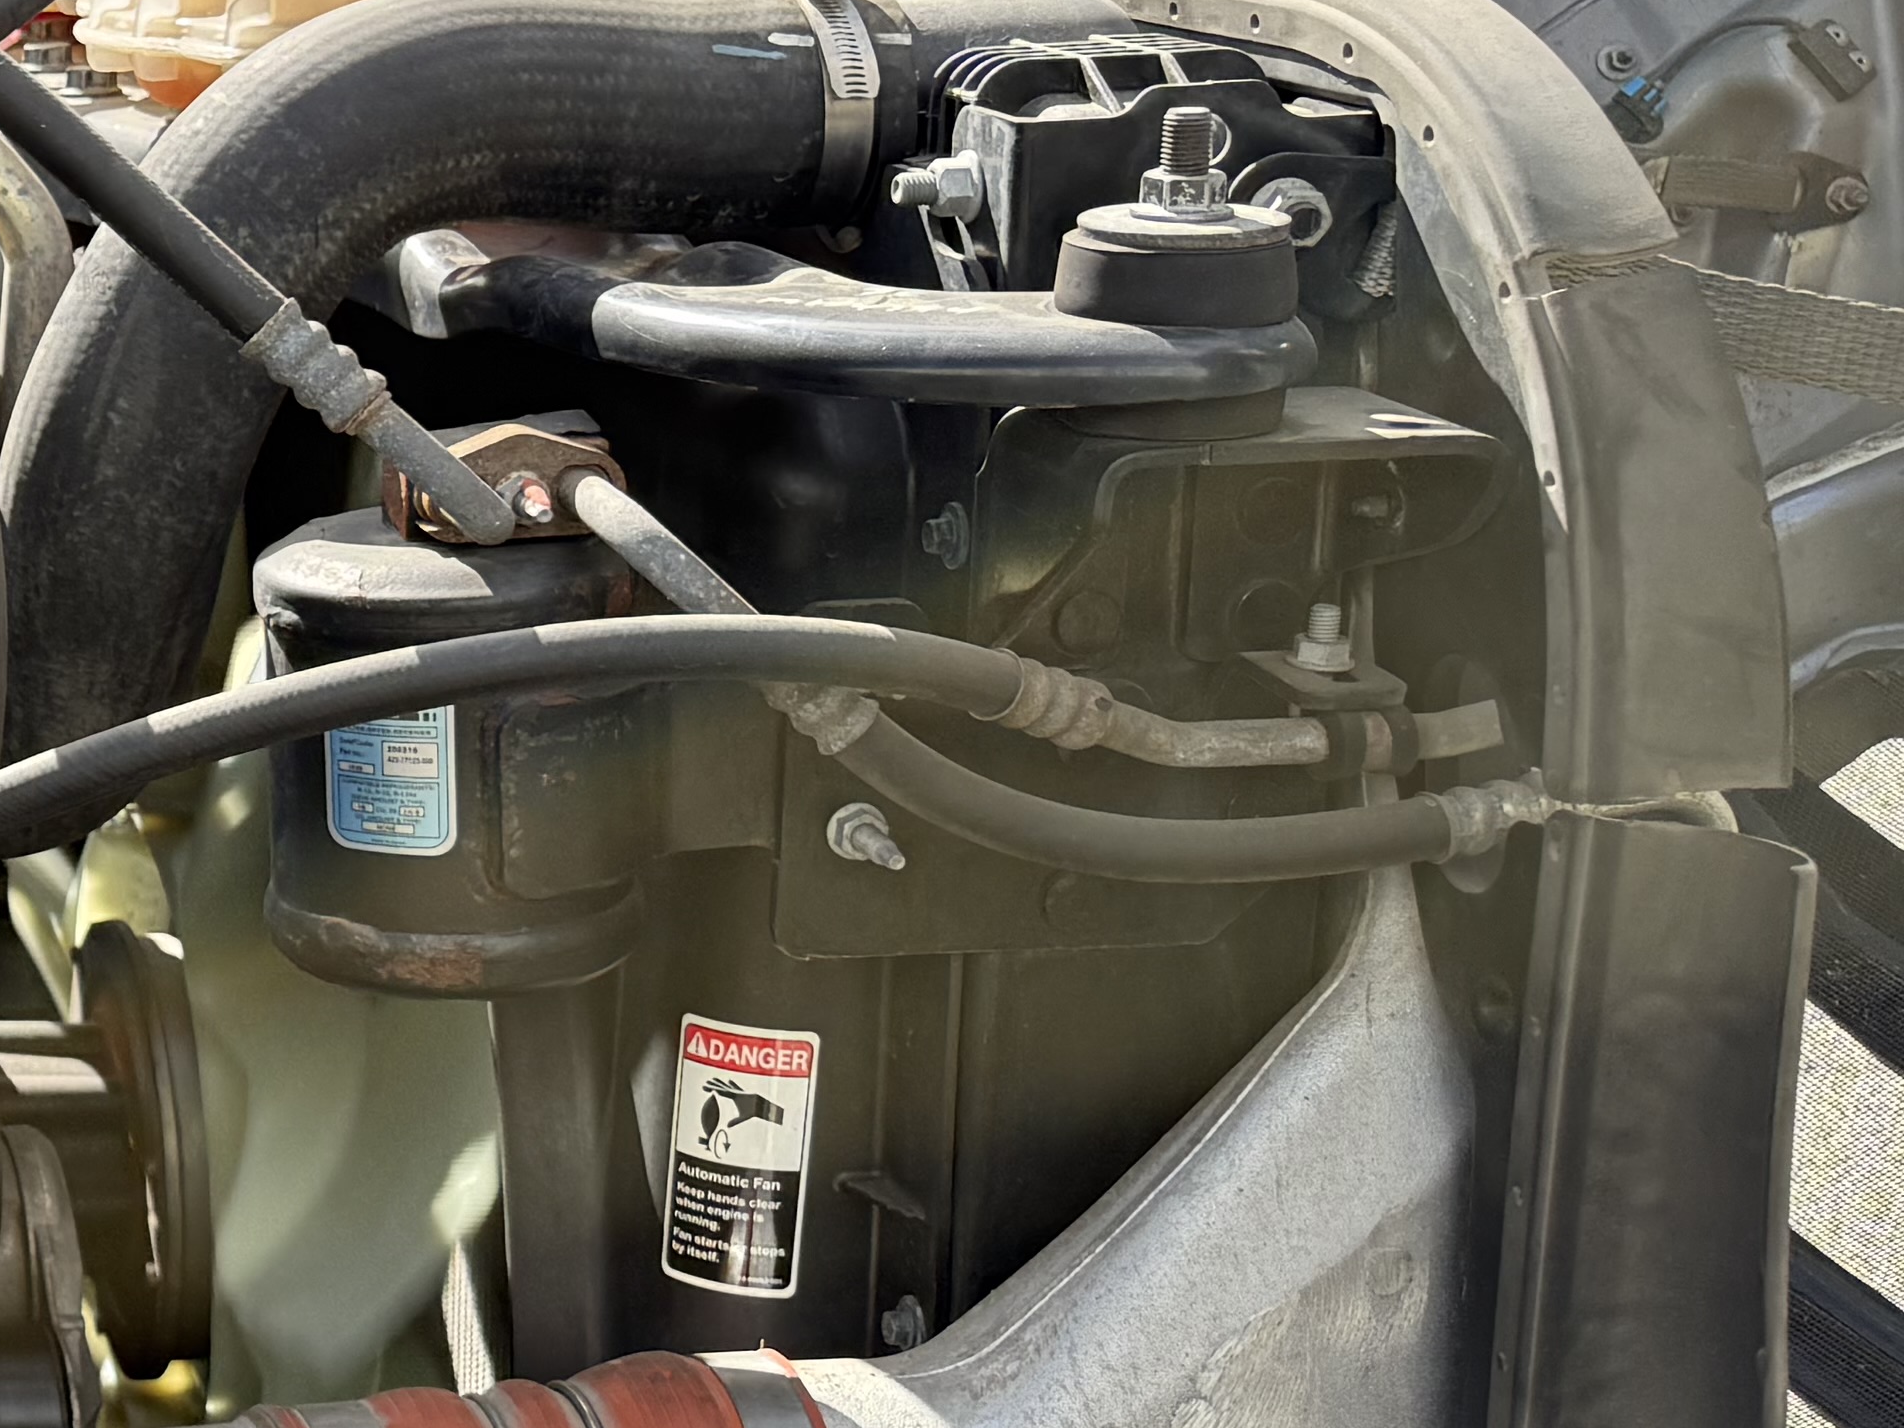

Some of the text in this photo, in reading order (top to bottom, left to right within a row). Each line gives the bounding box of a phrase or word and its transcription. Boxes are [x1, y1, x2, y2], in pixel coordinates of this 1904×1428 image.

[707, 1042, 808, 1072] DANGER
[678, 1161, 781, 1191] Automatic Fan
[675, 1196, 764, 1223] when engine is
[677, 1181, 782, 1210] Keep hands clear
[674, 1209, 720, 1233] running.
[672, 1239, 720, 1263] by itself.
[673, 1226, 693, 1242] Fan
[693, 1235, 729, 1251] starts
[750, 1245, 785, 1258] stops
